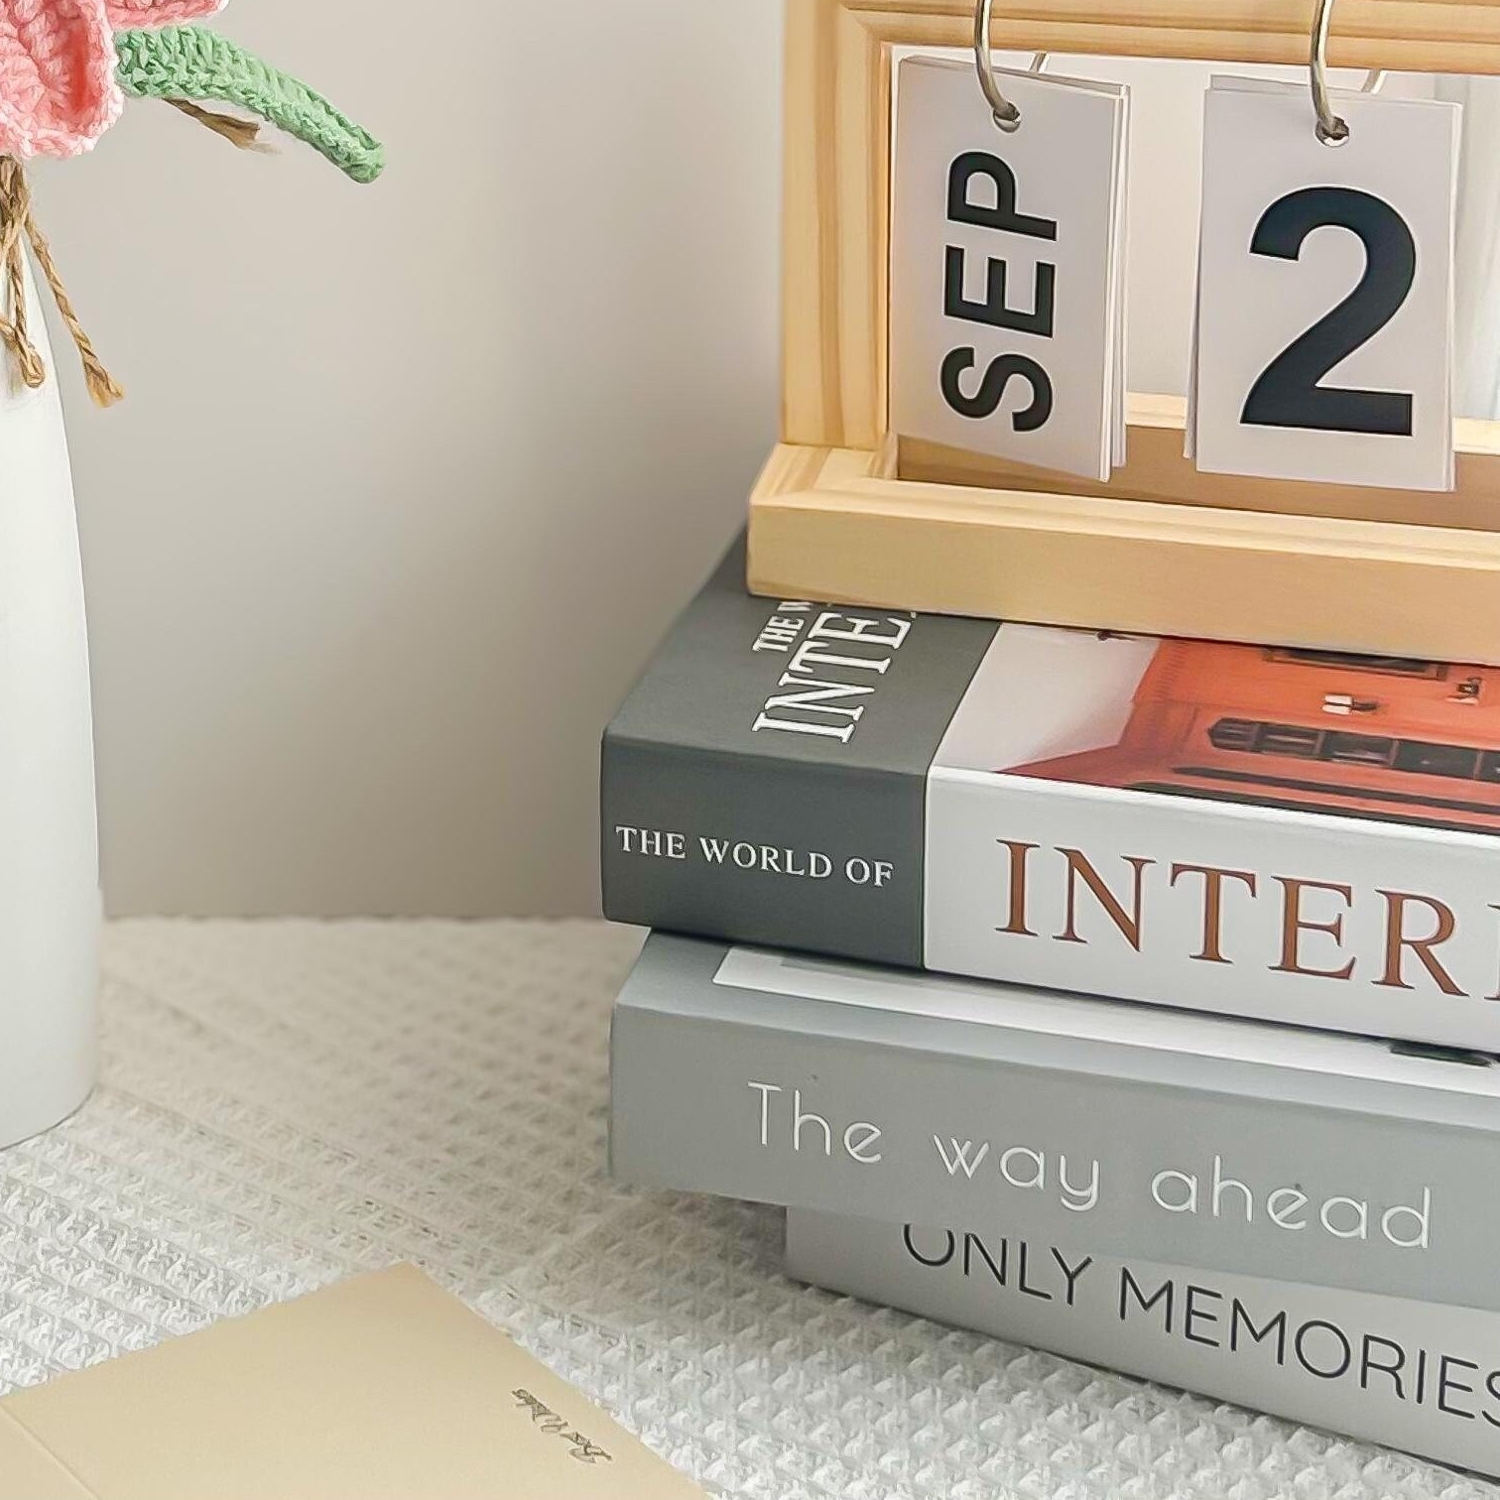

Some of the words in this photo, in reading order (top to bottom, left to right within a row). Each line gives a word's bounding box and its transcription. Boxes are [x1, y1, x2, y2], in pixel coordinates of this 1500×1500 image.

[940, 150, 1057, 432] SEP
[1239, 186, 1416, 437] 2
[751, 603, 917, 744] INTE
[752, 615, 805, 652] THE
[615, 825, 686, 859] THE
[700, 836, 833, 878] WORLD
[845, 858, 894, 887] OF
[995, 838, 1500, 1002] INTER
[747, 1081, 883, 1164] The
[933, 1133, 1100, 1212] way
[1151, 1154, 1432, 1250] ahead
[903, 1223, 1093, 1305] ONLY
